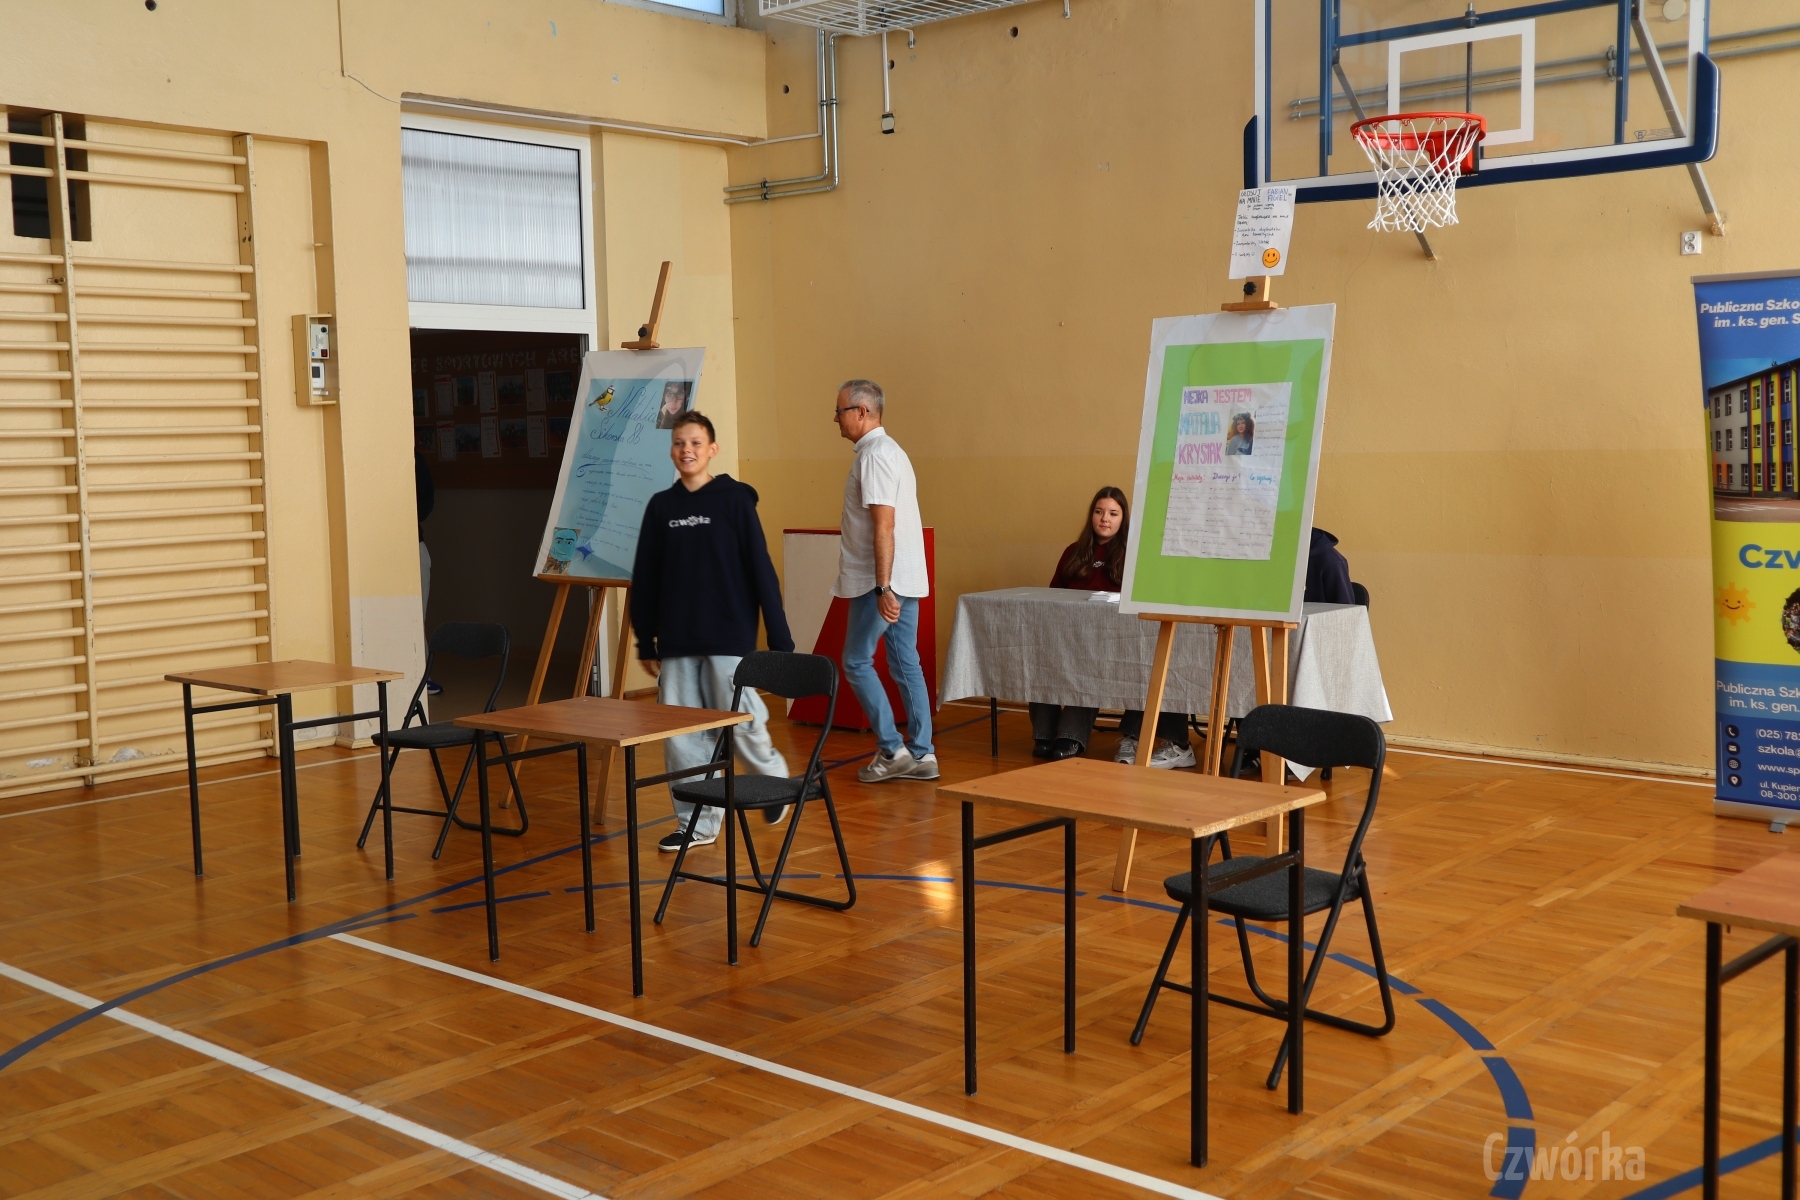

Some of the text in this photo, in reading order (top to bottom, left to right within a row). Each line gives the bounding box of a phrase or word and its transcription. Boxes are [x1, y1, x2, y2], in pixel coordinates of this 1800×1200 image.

[1700, 301, 1764, 314] Publiczna
[1738, 316, 1757, 326] ks.
[1759, 316, 1789, 328] gen.
[1213, 388, 1252, 403] JESTEM
[1178, 442, 1222, 465] KRYSIAK
[1716, 681, 1776, 696] Publiczna
[1729, 697, 1800, 713] im. ks. gen.
[1756, 729, 1783, 740] (025)
[1760, 789, 1797, 801] 08-300
